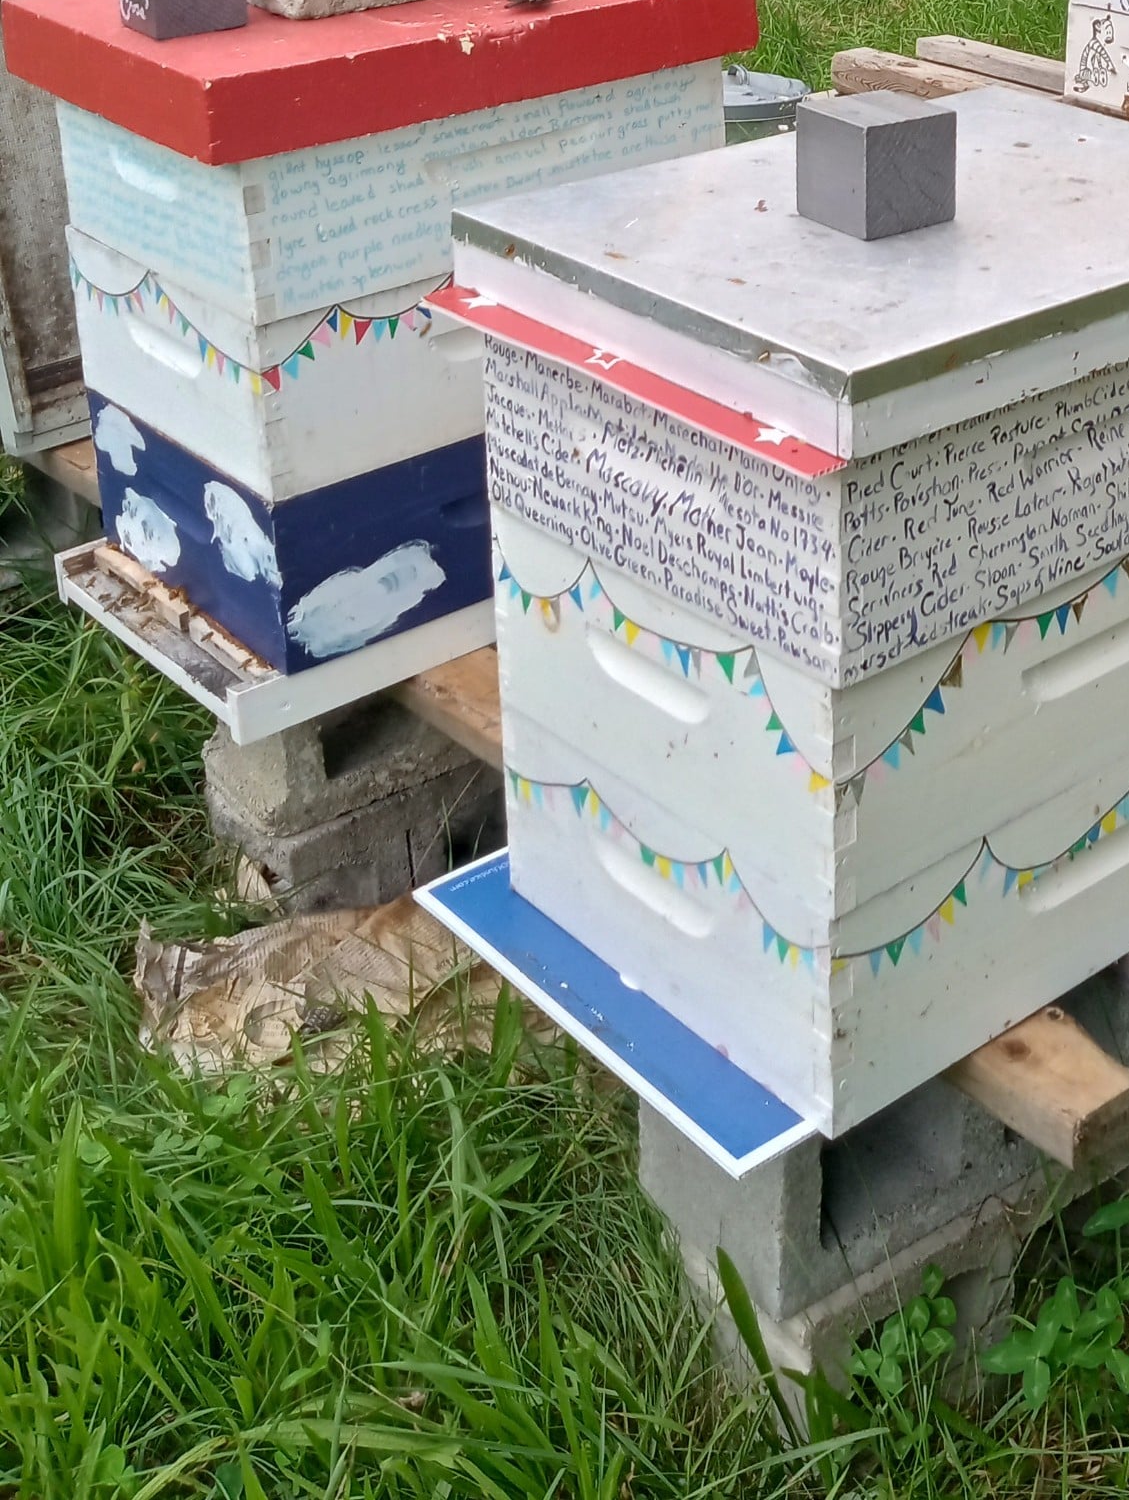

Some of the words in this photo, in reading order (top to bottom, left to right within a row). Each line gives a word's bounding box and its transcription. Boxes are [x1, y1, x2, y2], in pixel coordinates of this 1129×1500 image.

[484, 333, 517, 366] Rouge
[525, 351, 582, 393] Manerbe
[653, 410, 722, 454] Marechal
[485, 358, 538, 398] Marshall
[991, 416, 1044, 445] Pasture
[987, 474, 1014, 502] Red
[493, 481, 511, 507] Old
[664, 567, 723, 618] Paradise
[1049, 557, 1085, 581] Wine
